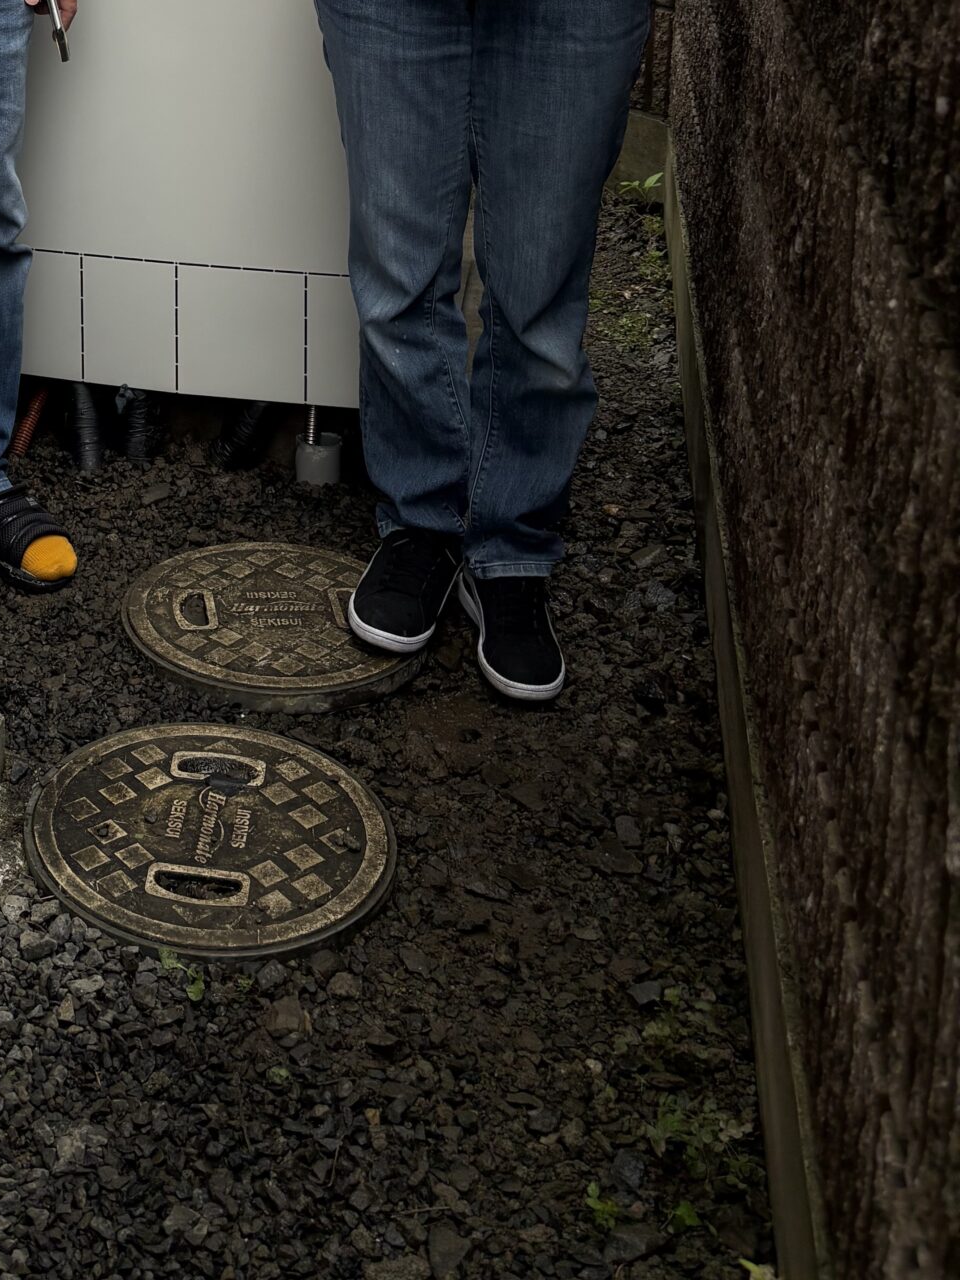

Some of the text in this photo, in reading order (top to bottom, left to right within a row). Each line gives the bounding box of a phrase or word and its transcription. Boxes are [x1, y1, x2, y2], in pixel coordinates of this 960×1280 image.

[246, 591, 297, 600] SEKISUI
[250, 617, 303, 627] SEKISUI
[165, 799, 188, 839] SEKISUI
[230, 808, 252, 849] SEKISUI
